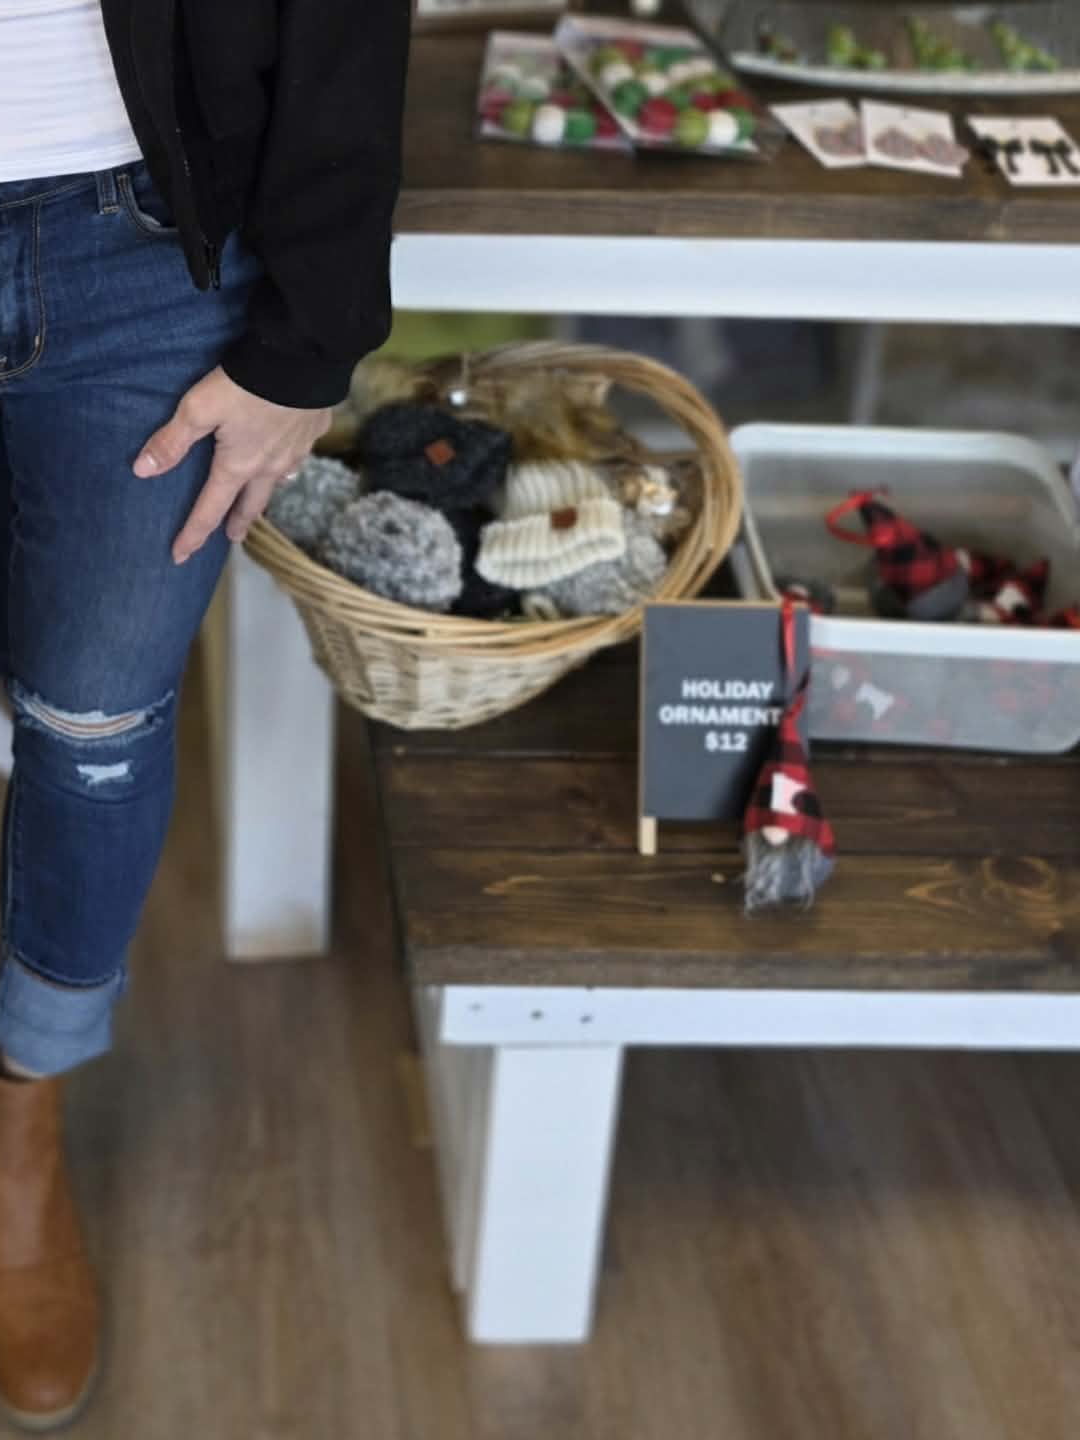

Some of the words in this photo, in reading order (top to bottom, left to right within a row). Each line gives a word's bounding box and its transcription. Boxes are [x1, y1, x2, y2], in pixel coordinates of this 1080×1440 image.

[681, 679, 775, 700] HOLIDAY
[659, 703, 782, 726] ORNAMENT
[704, 730, 748, 753] $12
